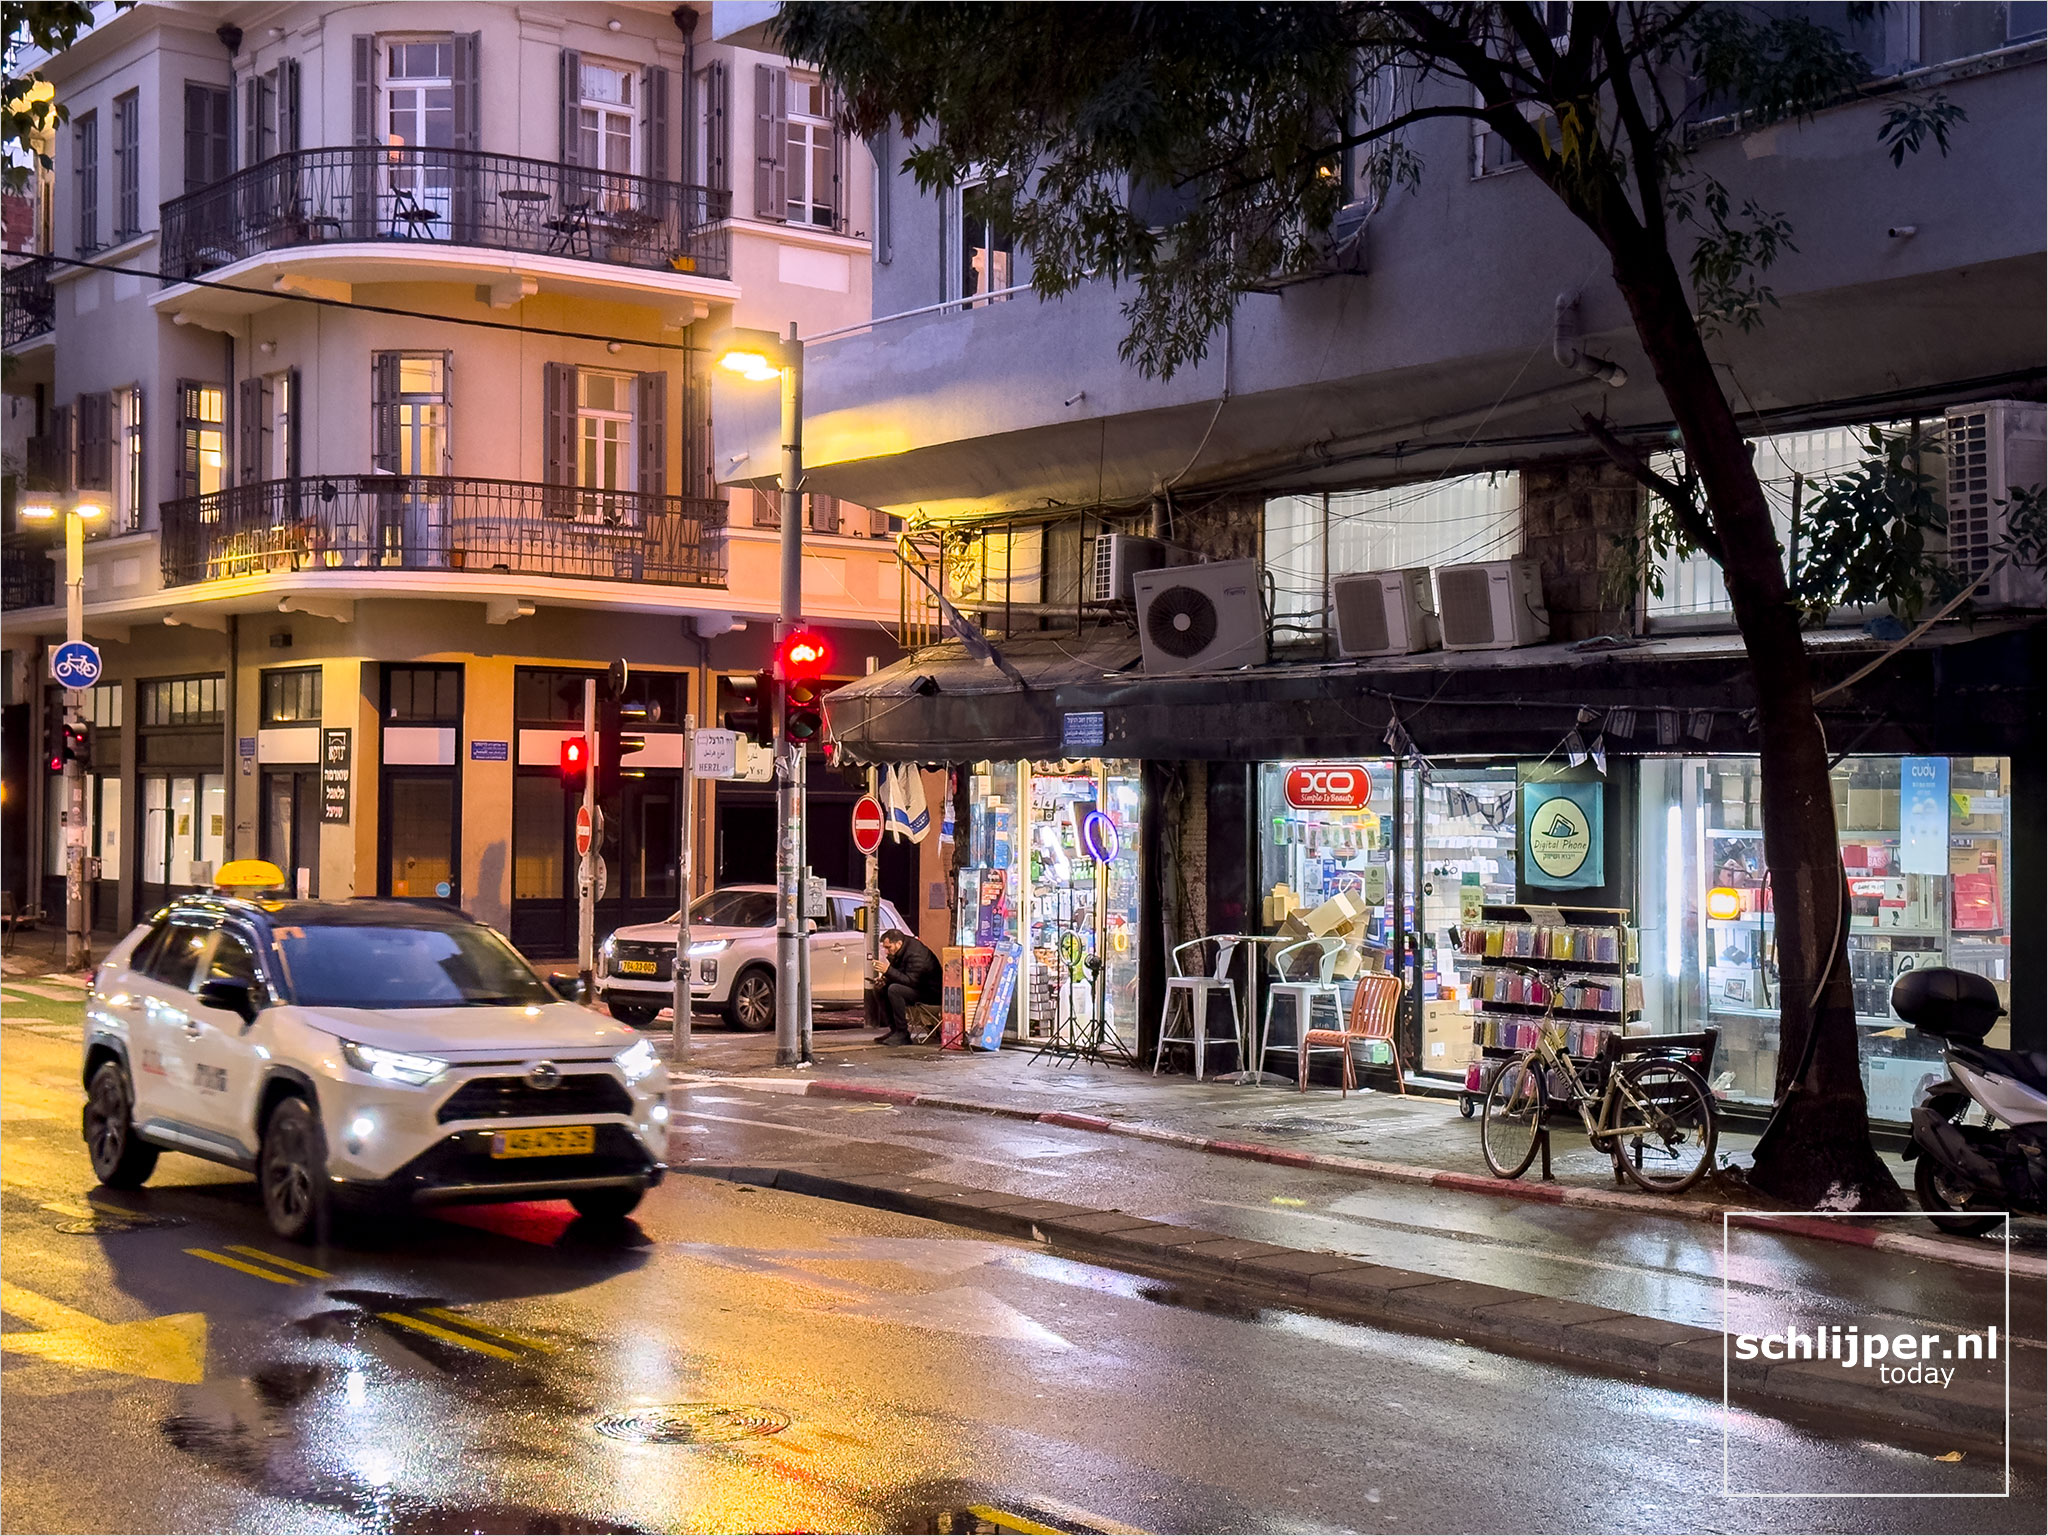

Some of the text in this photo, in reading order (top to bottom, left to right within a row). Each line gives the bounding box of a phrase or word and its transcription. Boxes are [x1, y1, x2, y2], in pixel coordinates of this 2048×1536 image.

[709, 734, 724, 745] הרצל
[698, 763, 720, 772] HERZL
[1911, 763, 1936, 779] cudy
[1300, 771, 1355, 793] XO
[1301, 793, 1323, 804] Simple
[1330, 793, 1355, 804] Beauty
[1534, 839, 1587, 851] Digital Phone
